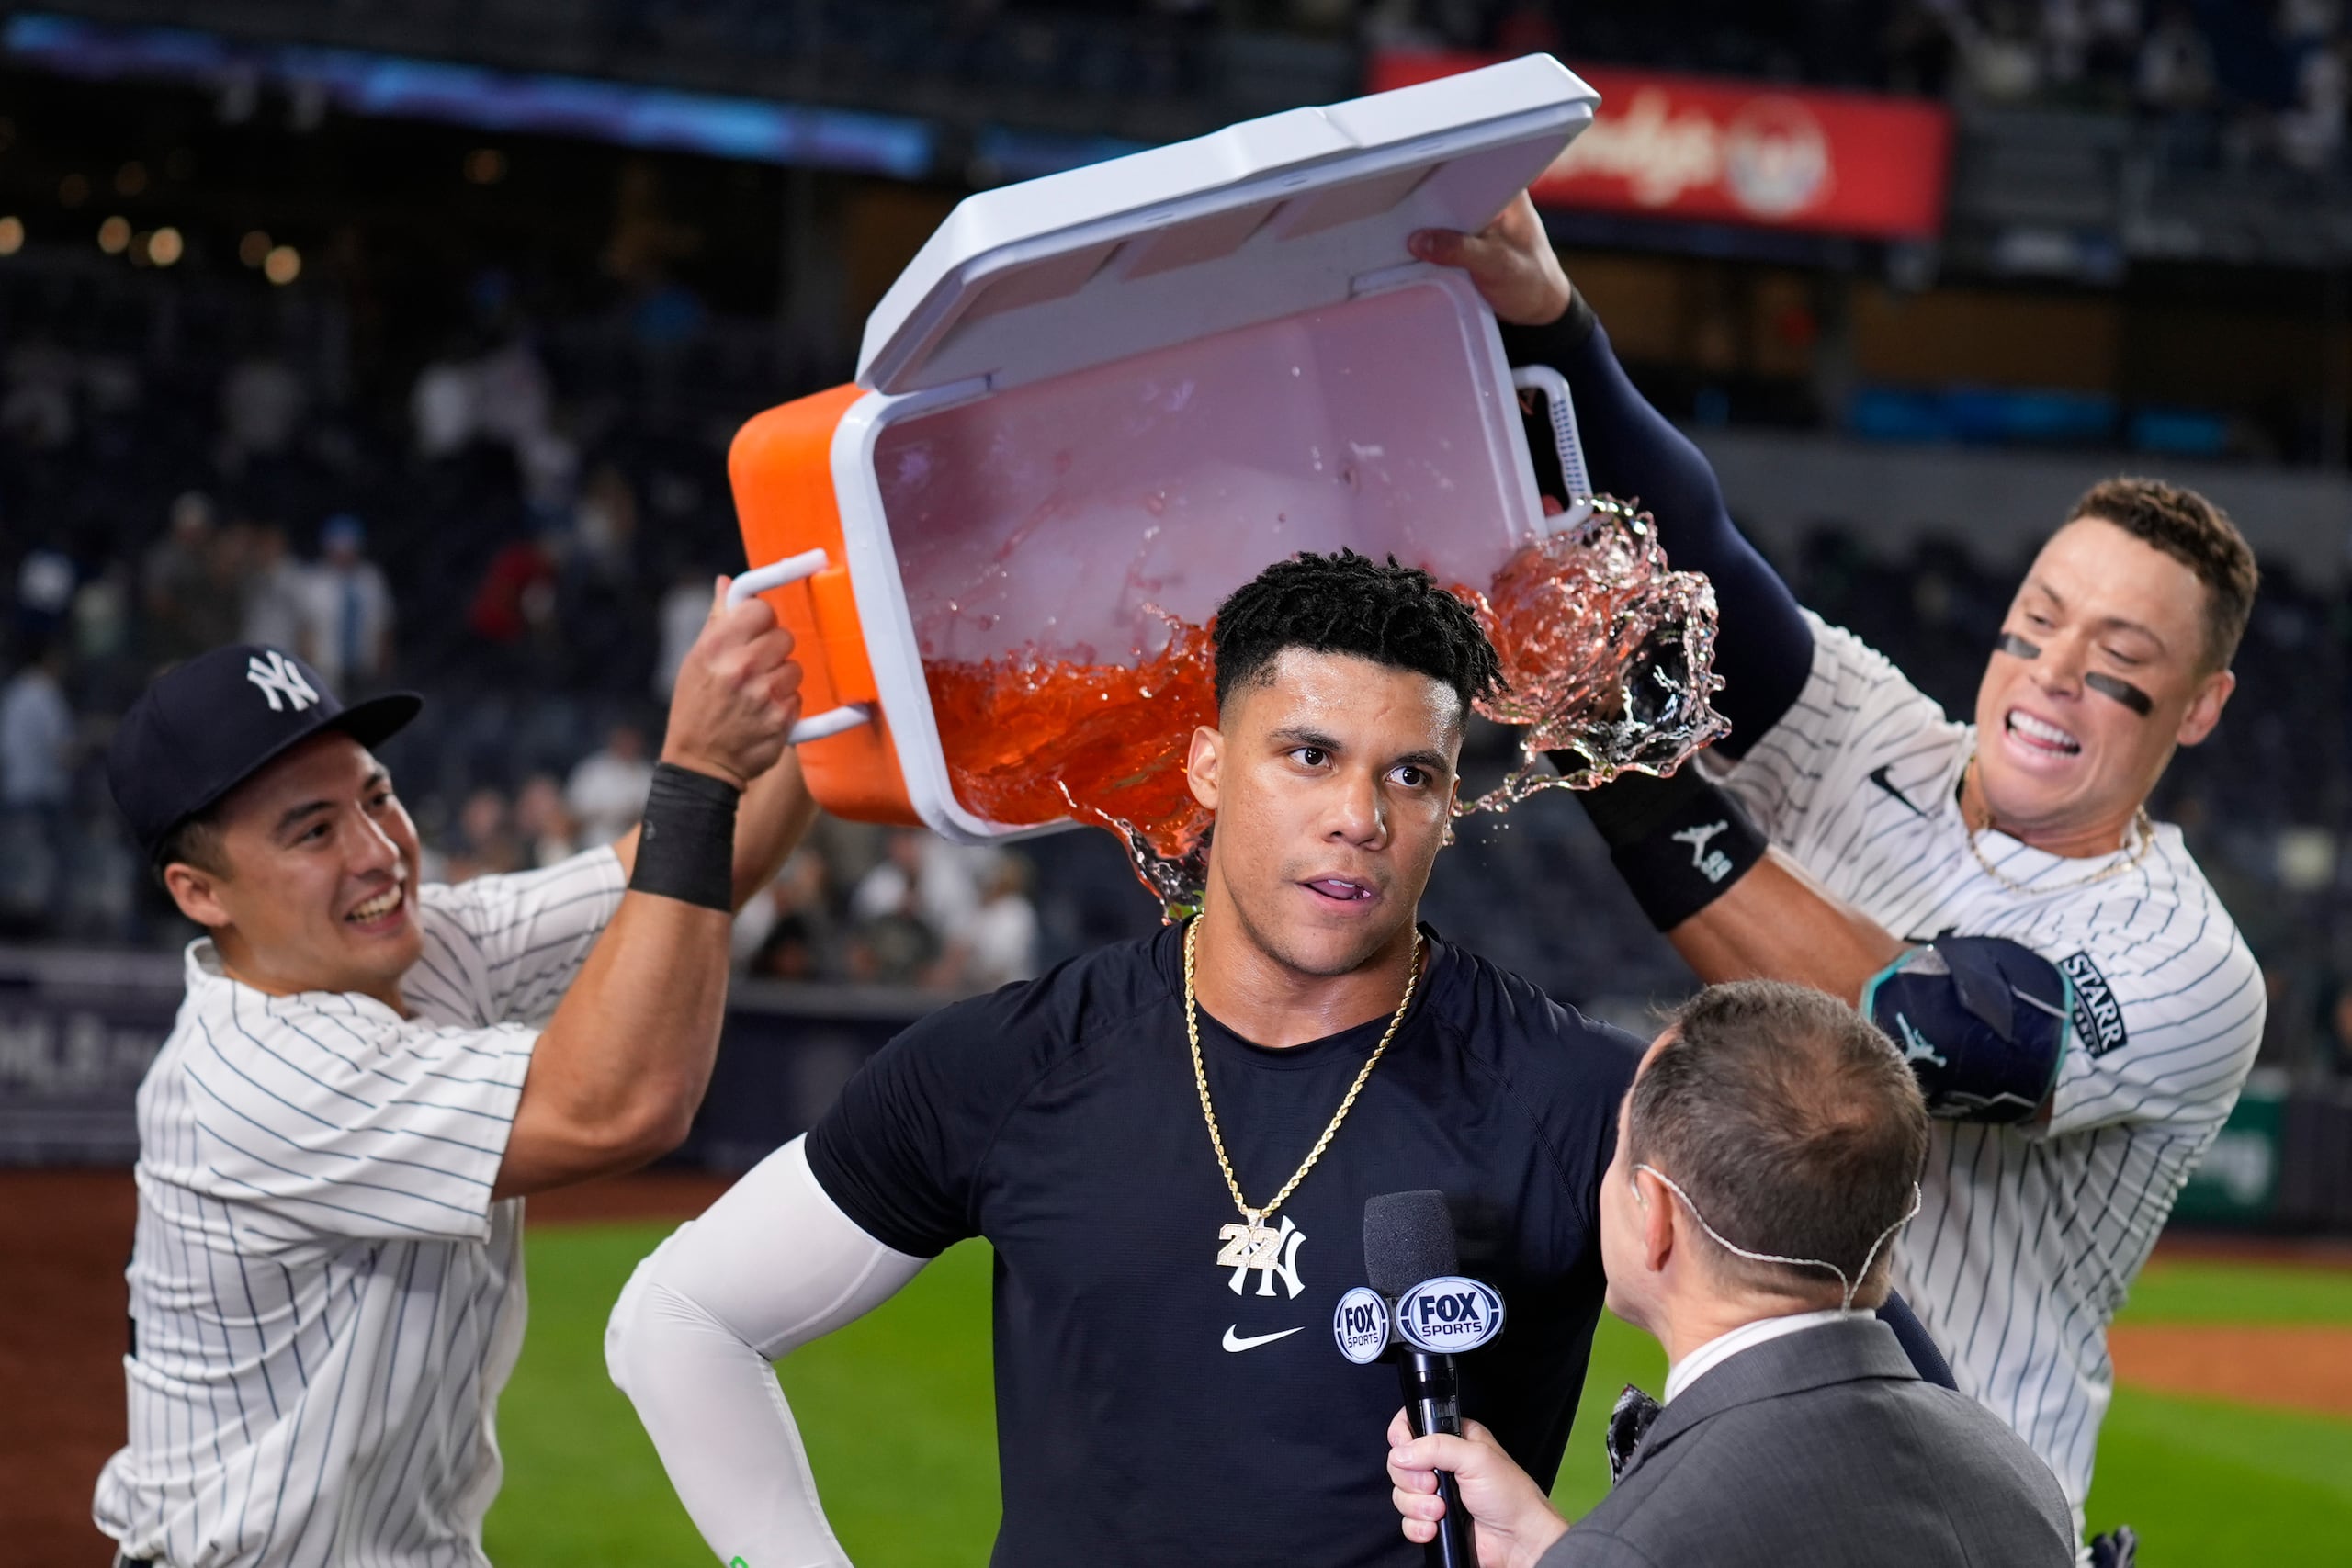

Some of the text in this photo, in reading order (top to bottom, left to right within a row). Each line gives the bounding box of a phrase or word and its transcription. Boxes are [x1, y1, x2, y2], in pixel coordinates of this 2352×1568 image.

[246, 649, 320, 712] NY
[2063, 954, 2123, 1052] STARR
[1216, 1223, 1281, 1270] 22
[1344, 1303, 1377, 1337] FOX
[1419, 1292, 1481, 1325] FOX
[1347, 1333, 1379, 1348] SPORTS
[1421, 1321, 1483, 1337] SPORTS
